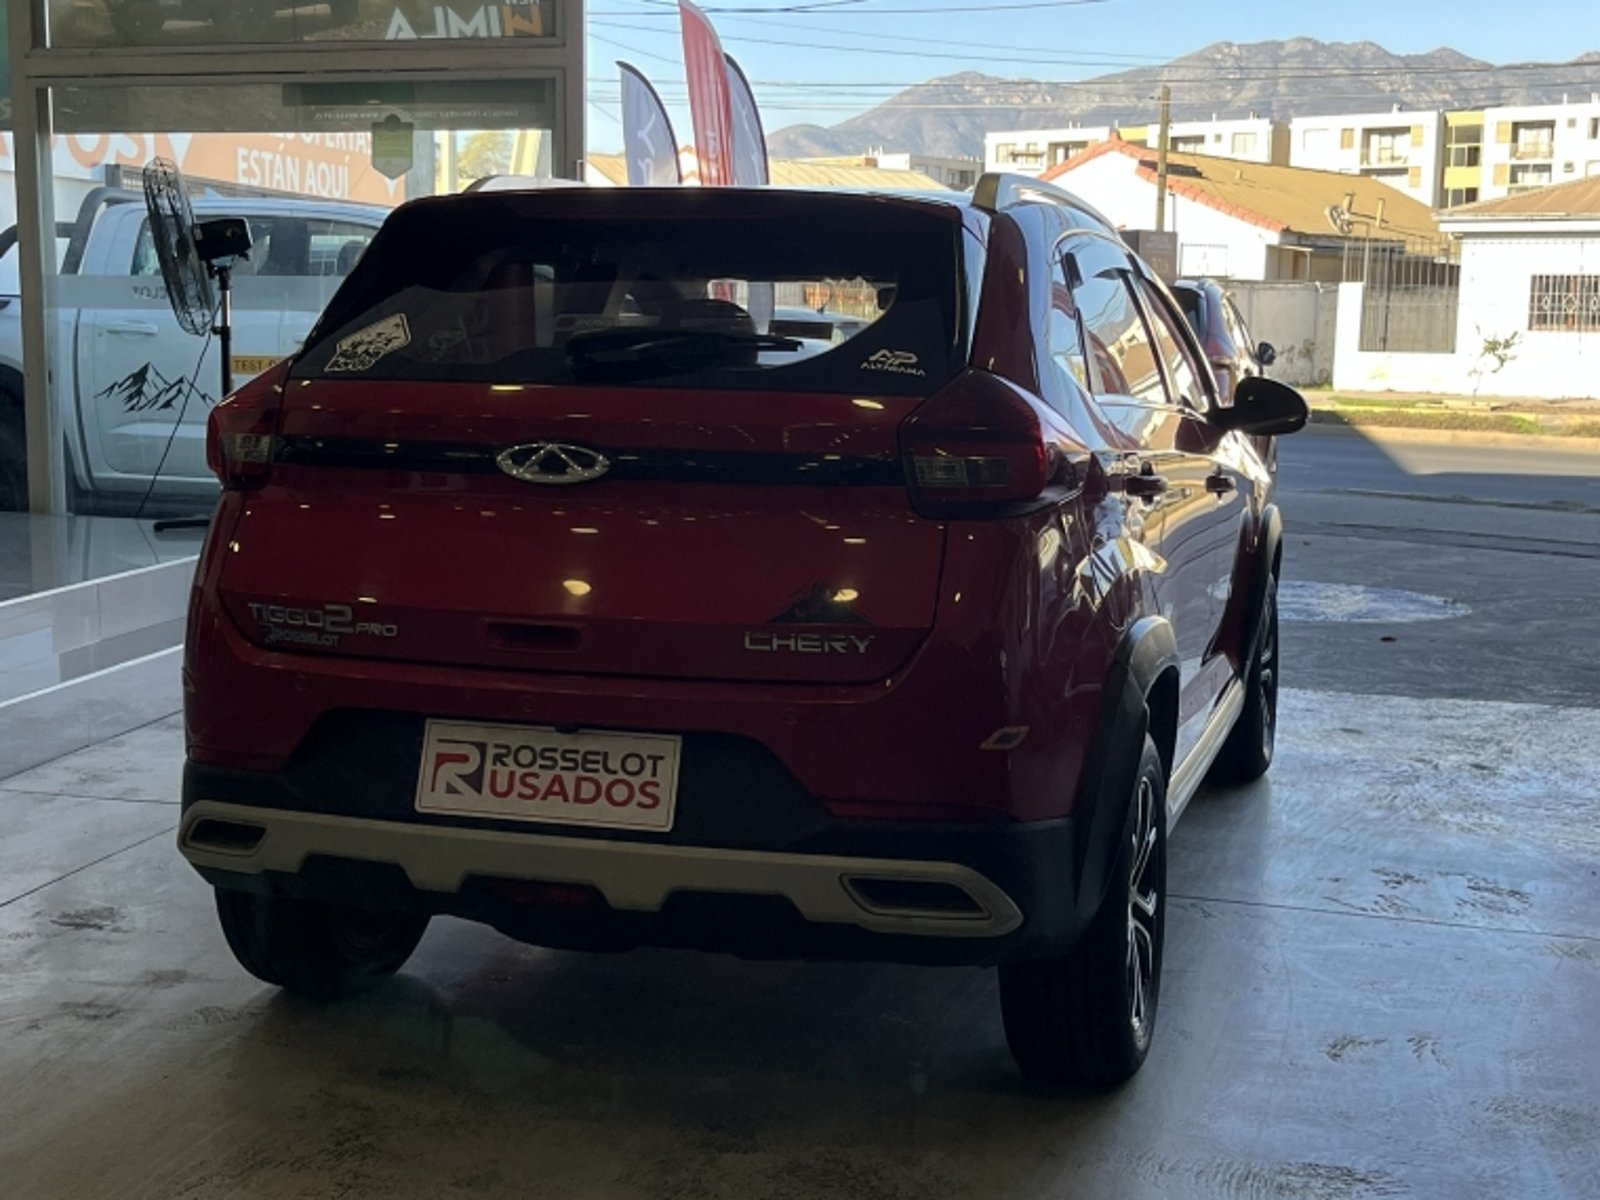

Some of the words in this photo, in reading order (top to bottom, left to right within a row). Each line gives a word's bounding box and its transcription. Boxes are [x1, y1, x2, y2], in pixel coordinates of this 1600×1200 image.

[237, 143, 299, 193] ESTÁN
[304, 155, 350, 199] AQUÍ
[744, 631, 876, 654] CHERY
[491, 743, 665, 778] ROSSELOT
[489, 769, 661, 810] USADOS
